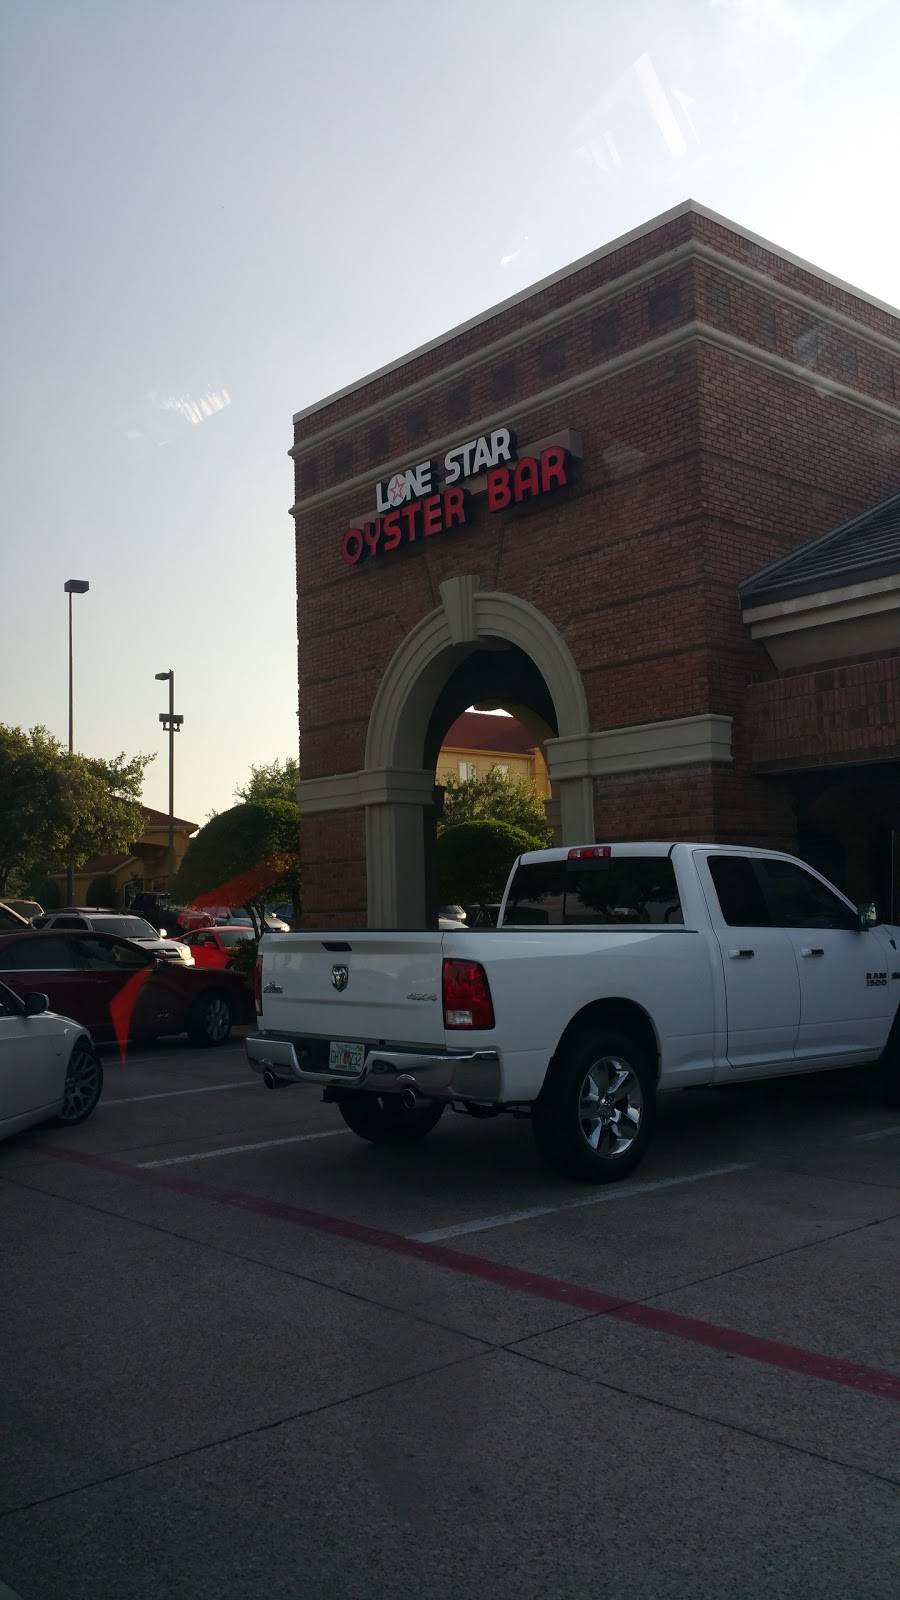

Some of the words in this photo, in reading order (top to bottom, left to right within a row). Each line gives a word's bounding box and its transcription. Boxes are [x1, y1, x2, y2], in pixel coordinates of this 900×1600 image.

[340, 487, 465, 565] OYSTER
[487, 446, 567, 512] BAR
[376, 460, 431, 513] LONE
[444, 428, 511, 484] STAR
[866, 979, 887, 987] 1500
